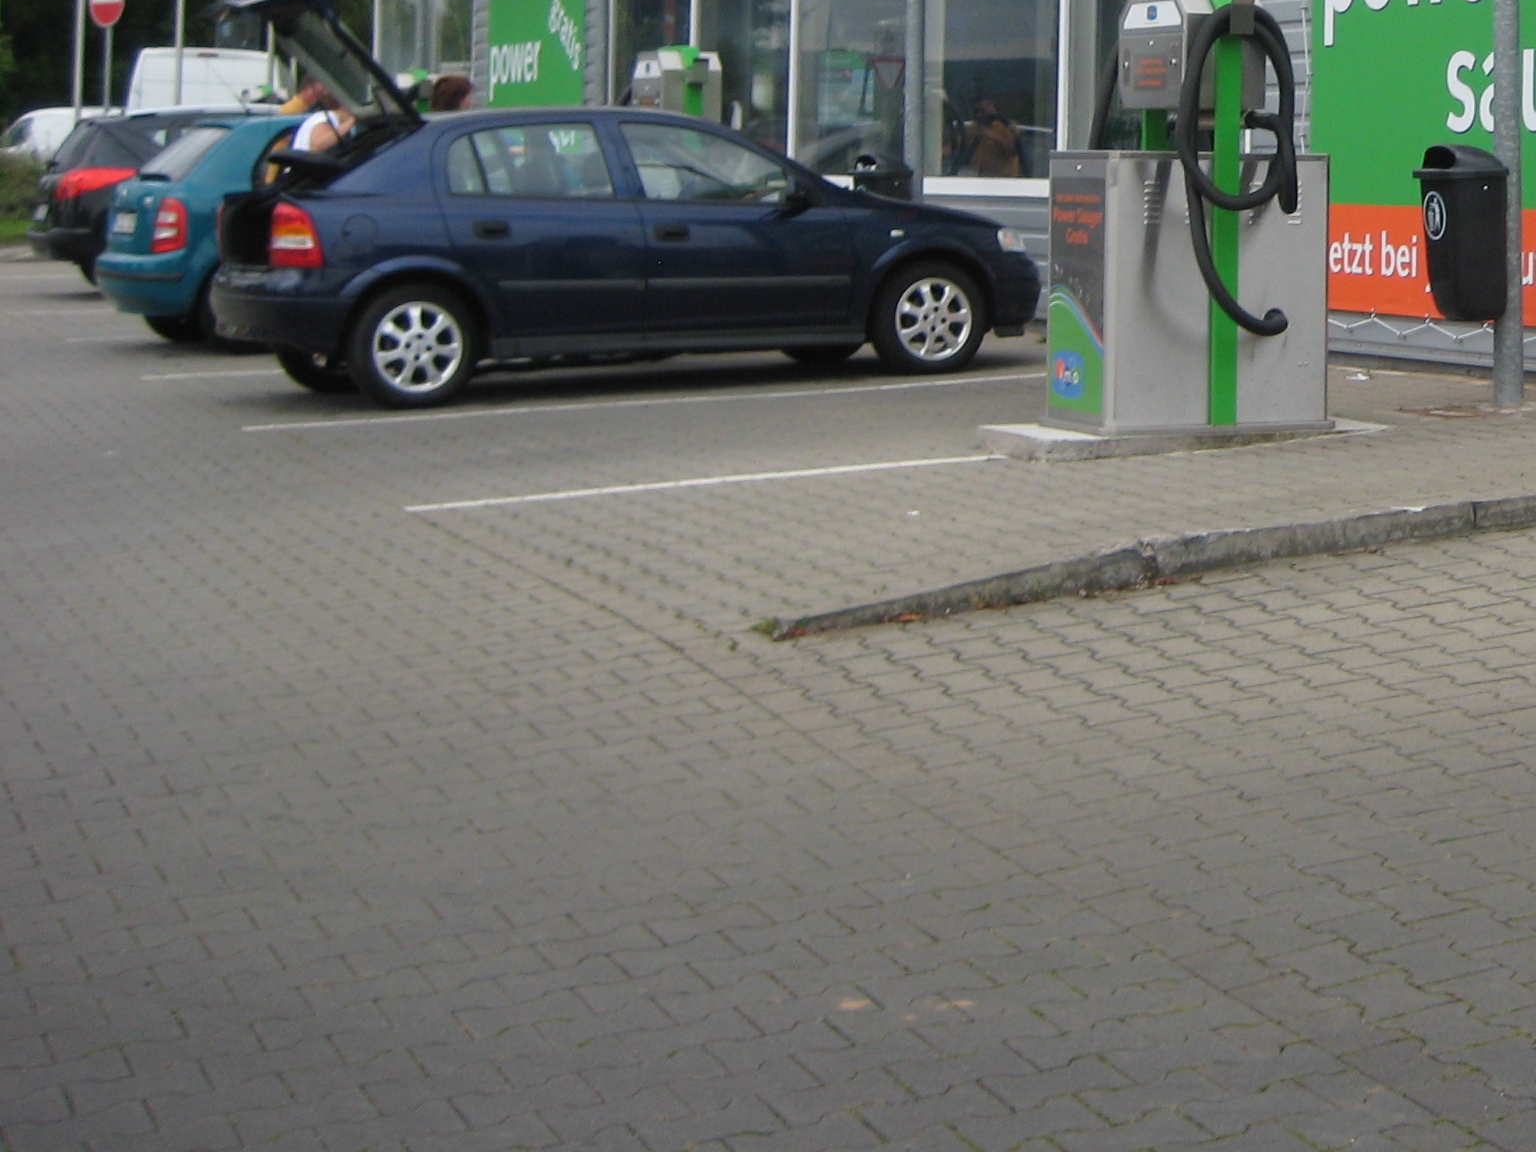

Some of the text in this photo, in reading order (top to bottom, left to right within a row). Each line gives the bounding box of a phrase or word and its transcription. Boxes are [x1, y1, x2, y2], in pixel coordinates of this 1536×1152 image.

[489, 40, 541, 102] power
[1328, 230, 1418, 277] etzt bei
